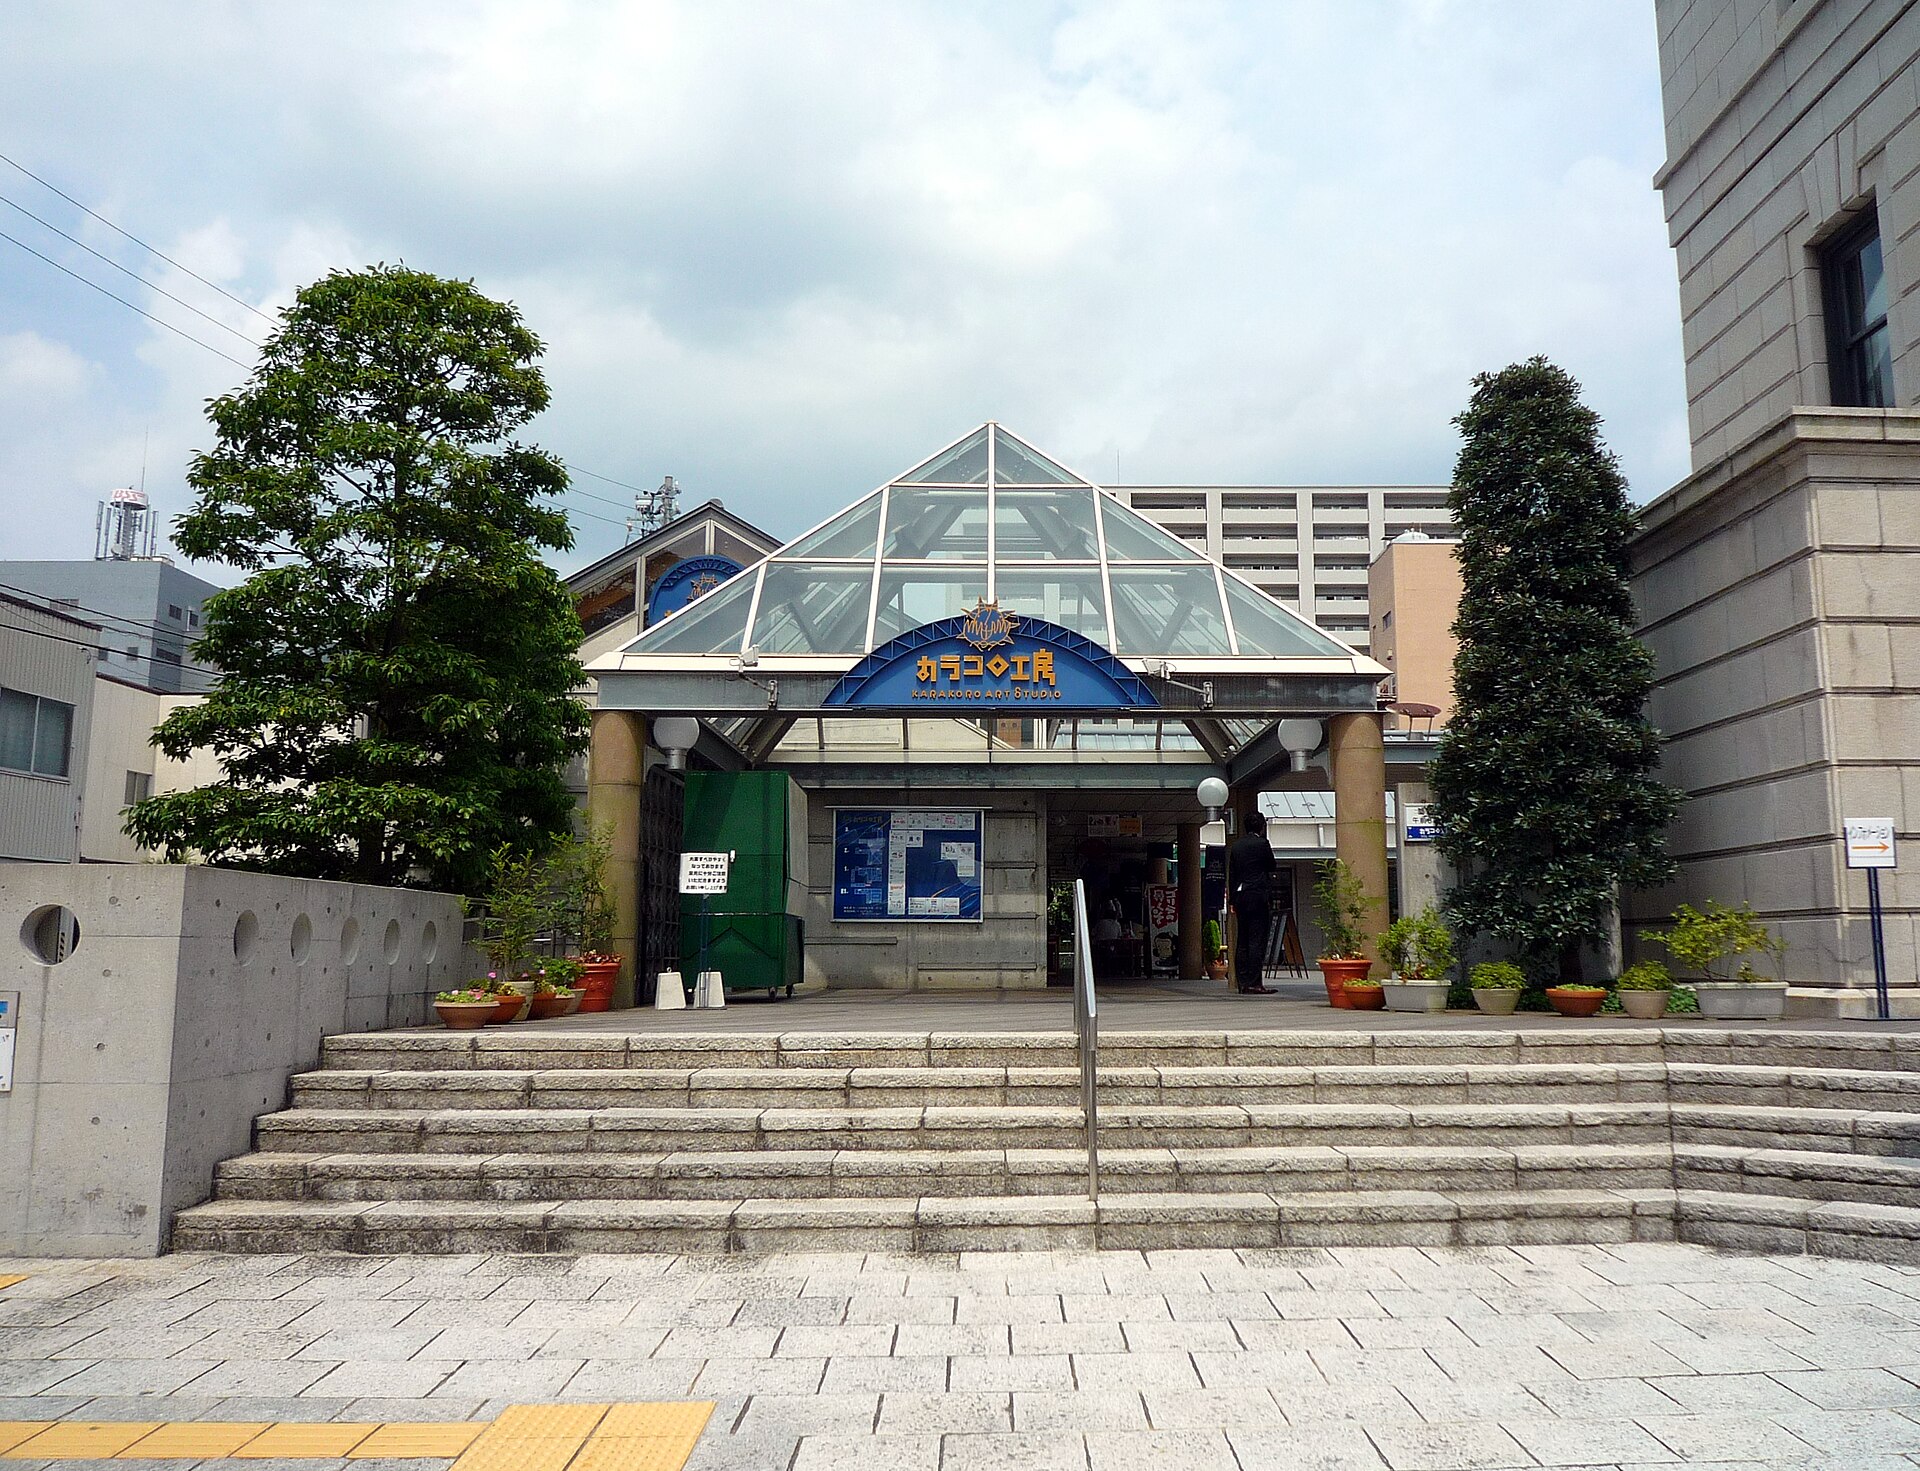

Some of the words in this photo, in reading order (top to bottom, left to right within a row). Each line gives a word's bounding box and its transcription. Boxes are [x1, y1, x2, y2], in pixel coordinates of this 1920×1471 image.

[911, 688, 981, 699] KARAKORO
[984, 689, 1010, 698] ART
[1013, 686, 1062, 699] STUDIO
